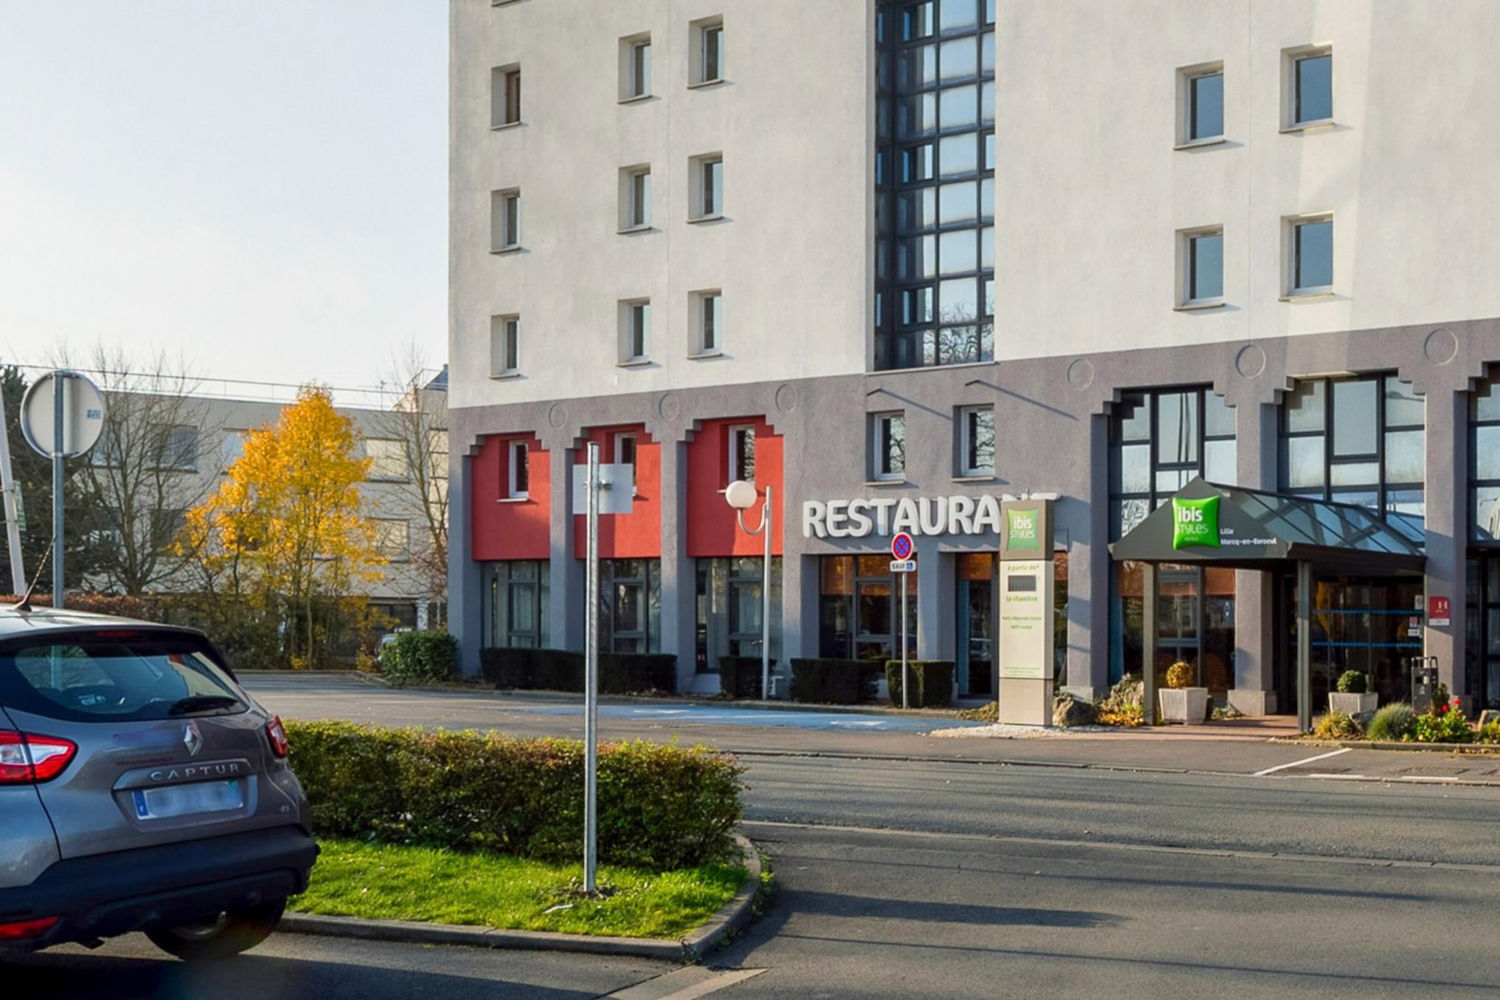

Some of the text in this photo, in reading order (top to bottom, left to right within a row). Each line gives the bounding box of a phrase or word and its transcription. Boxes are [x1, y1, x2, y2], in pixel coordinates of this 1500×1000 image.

[803, 493, 1060, 539] RESTAURA
[1013, 515, 1032, 529] ibis
[1178, 506, 1203, 522] ibis
[151, 763, 239, 780] CAPTUR
